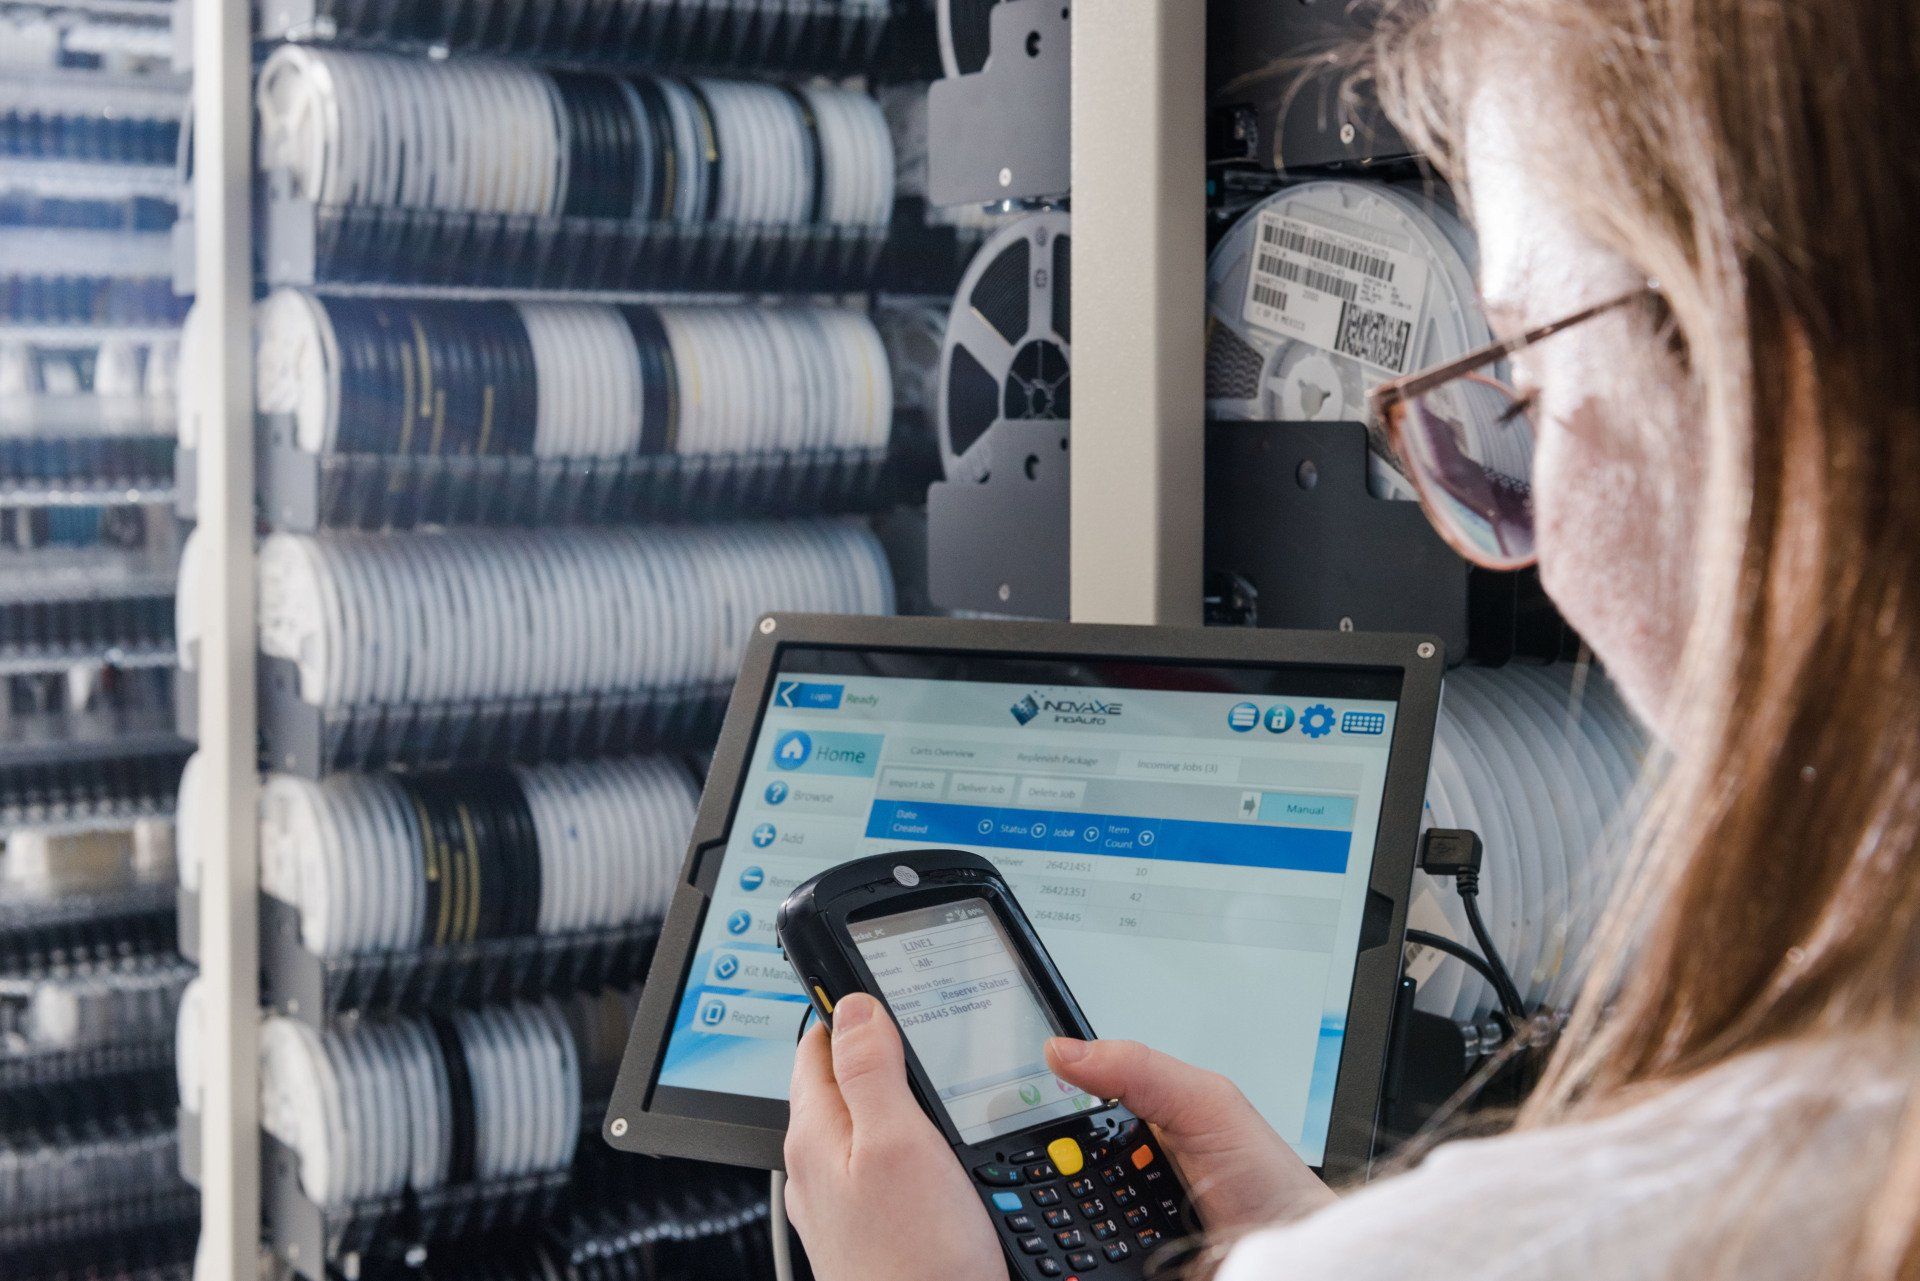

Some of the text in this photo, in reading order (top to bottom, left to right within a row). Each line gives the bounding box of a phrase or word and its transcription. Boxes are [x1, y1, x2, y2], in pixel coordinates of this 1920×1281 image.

[846, 693, 880, 707] Ready
[816, 746, 865, 764] Home
[911, 747, 976, 758] Carts Overview
[1017, 752, 1099, 767] Replenish Package
[1138, 760, 1181, 773] Incoming
[1182, 763, 1203, 773] Jobs
[920, 781, 936, 790] Job
[957, 783, 1006, 795] Deliver Job
[793, 790, 834, 803] Browse
[1028, 788, 1077, 799] Delete Job
[896, 809, 918, 819] Date
[1286, 804, 1325, 816] Manual
[893, 823, 929, 834] Created
[1000, 824, 1028, 835] Status
[1053, 828, 1076, 838] Job#
[1108, 825, 1130, 835] Item
[781, 833, 805, 845] Add
[1105, 838, 1134, 849] Count
[1046, 861, 1092, 873] 26421451
[1136, 867, 1148, 877] 10
[1040, 885, 1086, 898] 26421351
[1129, 892, 1142, 903] 42
[1035, 910, 1082, 923] 26428445
[1118, 917, 1138, 928] 196
[903, 938, 935, 953] LINE1
[744, 966, 761, 978] Kit
[911, 981, 932, 994] Work
[933, 975, 956, 988] Order:
[941, 977, 1010, 1001] Reserve Status
[891, 999, 921, 1013] Name
[731, 1010, 770, 1026] Report
[901, 999, 993, 1028] 26428445 Shortage
[1115, 1165, 1124, 1177] 3
[1084, 1178, 1094, 1190] 2
[1128, 1184, 1137, 1196] 6
[1050, 1188, 1059, 1200] 1
[1094, 1198, 1104, 1211] 5
[1062, 1208, 1071, 1221] 4
[1140, 1205, 1148, 1217] 9
[1015, 1216, 1028, 1225] TAB
[1107, 1219, 1117, 1232] 8
[1073, 1229, 1081, 1242] 7
[1025, 1237, 1042, 1248] SHIFT
[1118, 1240, 1128, 1253] 0
